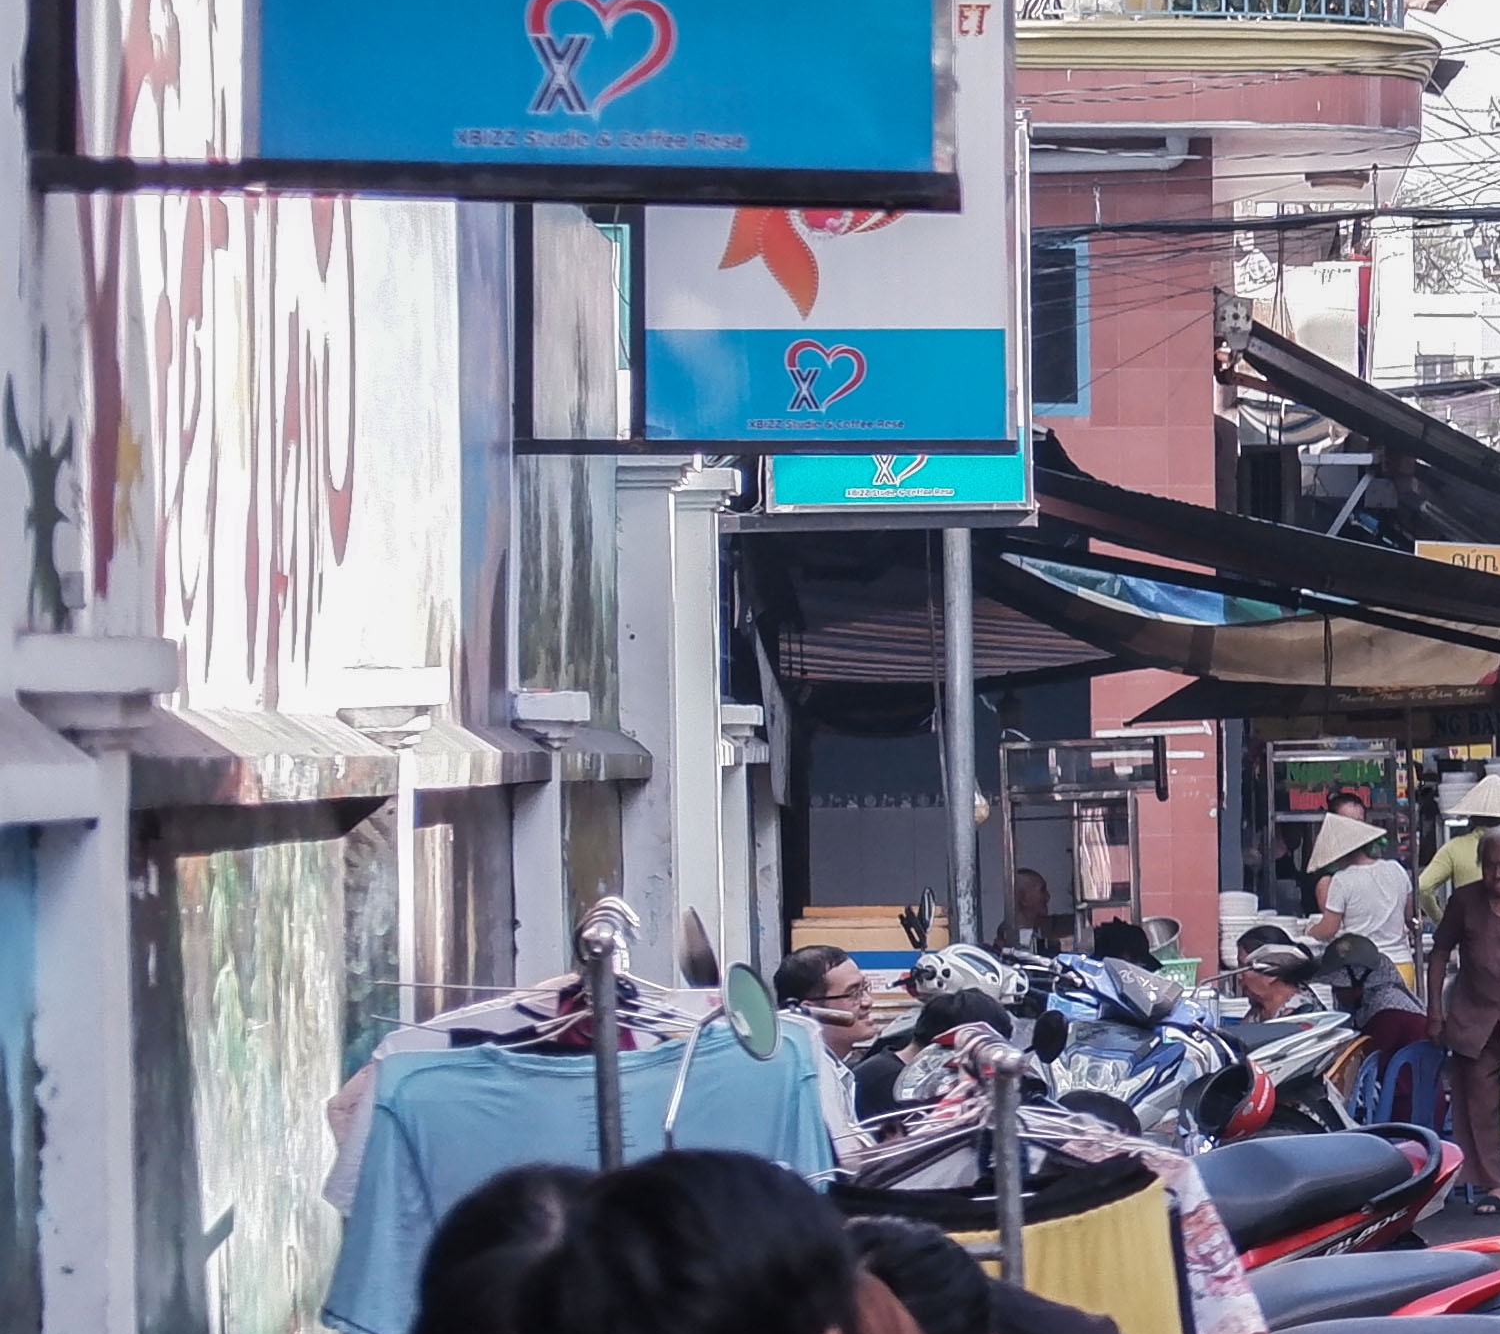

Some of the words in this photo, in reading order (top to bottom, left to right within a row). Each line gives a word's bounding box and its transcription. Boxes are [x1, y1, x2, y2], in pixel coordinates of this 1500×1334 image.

[958, 4, 991, 37] ET
[454, 127, 518, 148] XBIZZ
[523, 127, 590, 149] Studio
[595, 129, 611, 149] &
[617, 129, 689, 150] Coffee
[693, 131, 747, 150] Rose
[785, 420, 822, 429] Studio
[836, 419, 874, 429] Coffee
[877, 420, 905, 429] Rose
